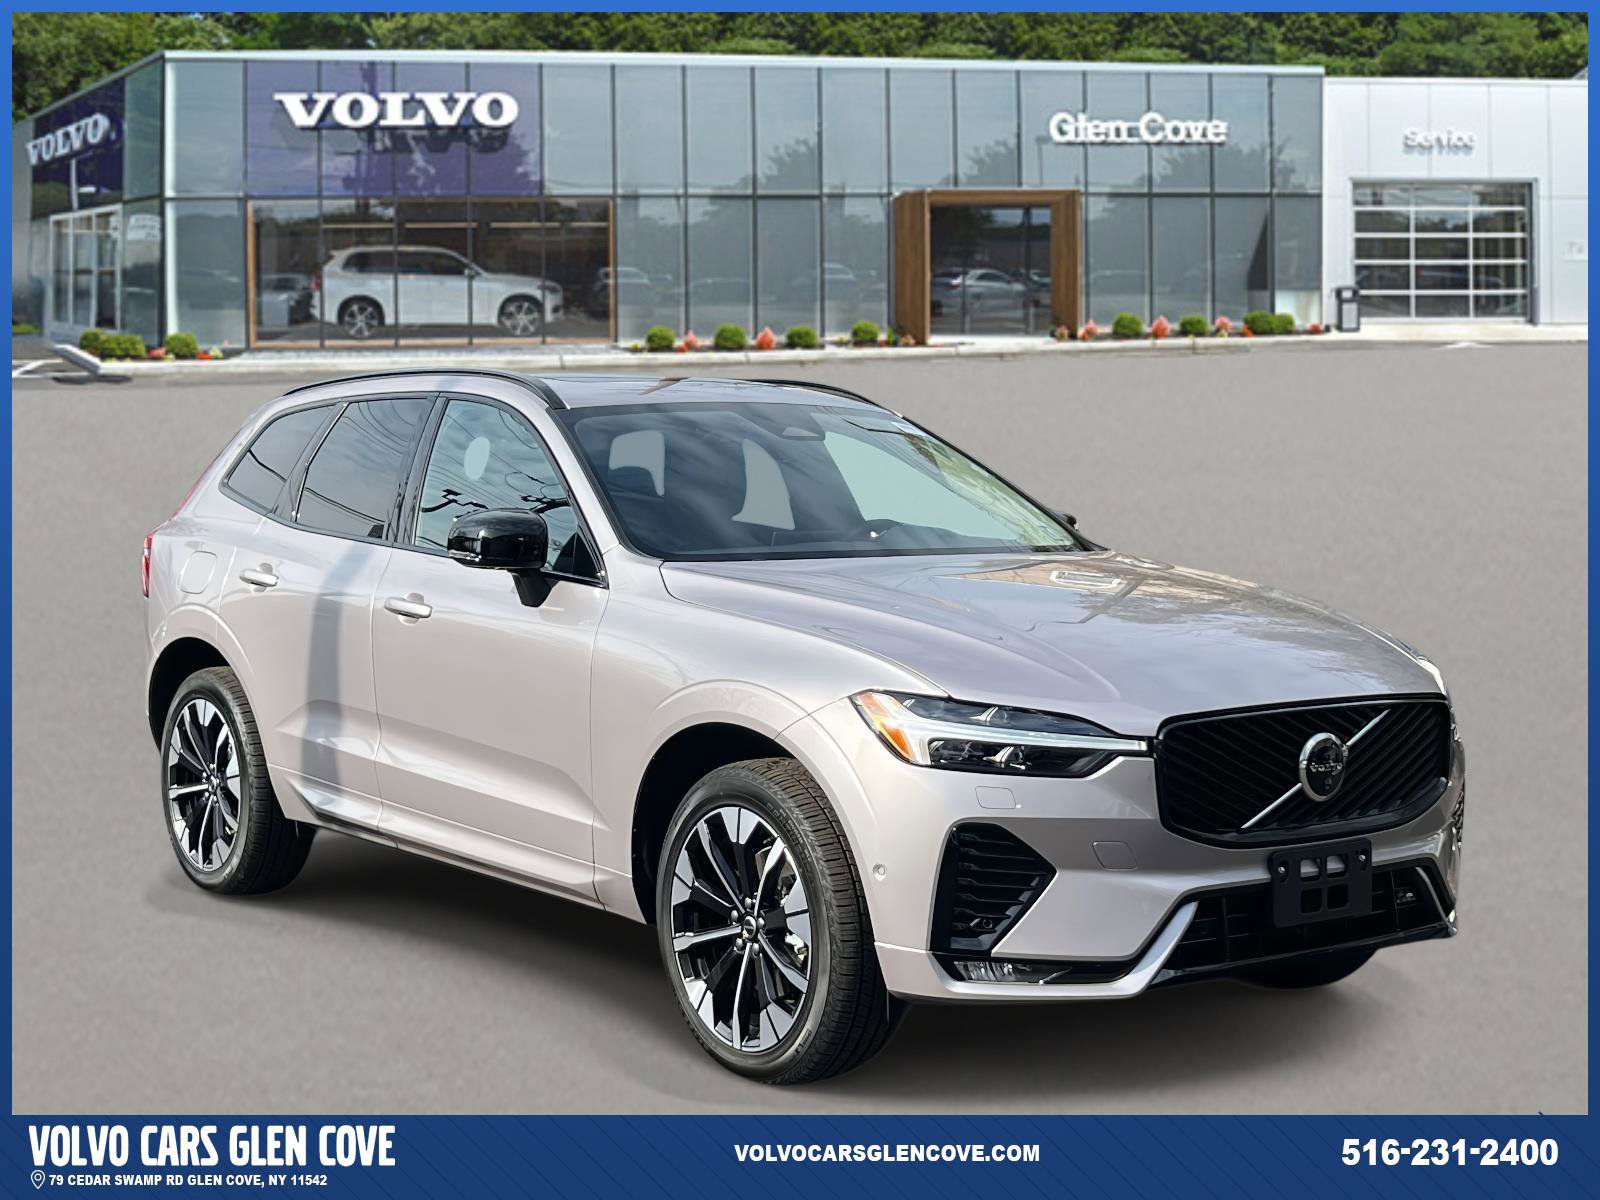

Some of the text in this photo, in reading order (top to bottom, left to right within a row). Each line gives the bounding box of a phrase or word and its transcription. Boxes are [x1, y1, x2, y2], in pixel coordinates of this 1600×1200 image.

[274, 92, 519, 128] VOLVO
[25, 112, 111, 165] VOLVO
[1049, 111, 1228, 144] Glen Cove
[1403, 127, 1476, 153] Service
